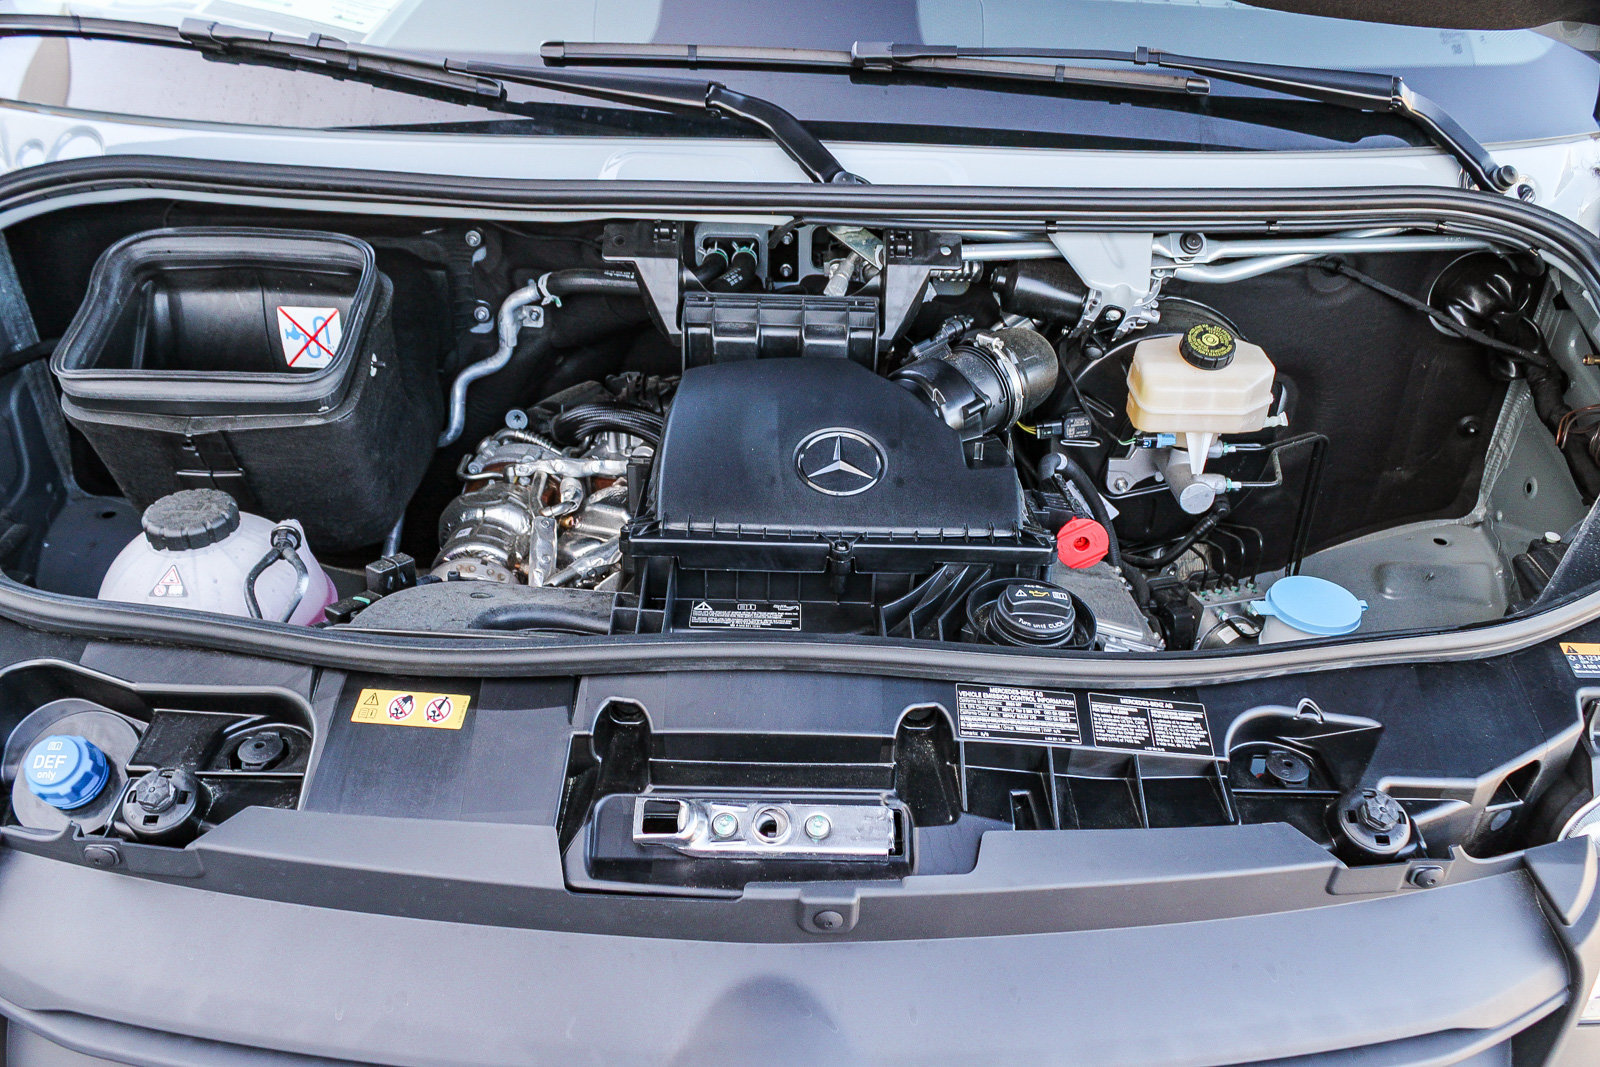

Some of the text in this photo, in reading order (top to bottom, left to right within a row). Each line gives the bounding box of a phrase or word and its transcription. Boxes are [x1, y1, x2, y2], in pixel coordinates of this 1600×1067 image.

[1018, 618, 1031, 627] Turn
[1048, 621, 1065, 629] CLICK
[958, 690, 1075, 705] VEHICLE EMISSION CONTROL INFORMATION
[1120, 698, 1164, 708] MERCEDES-BENZ
[33, 755, 67, 781] DEF only
